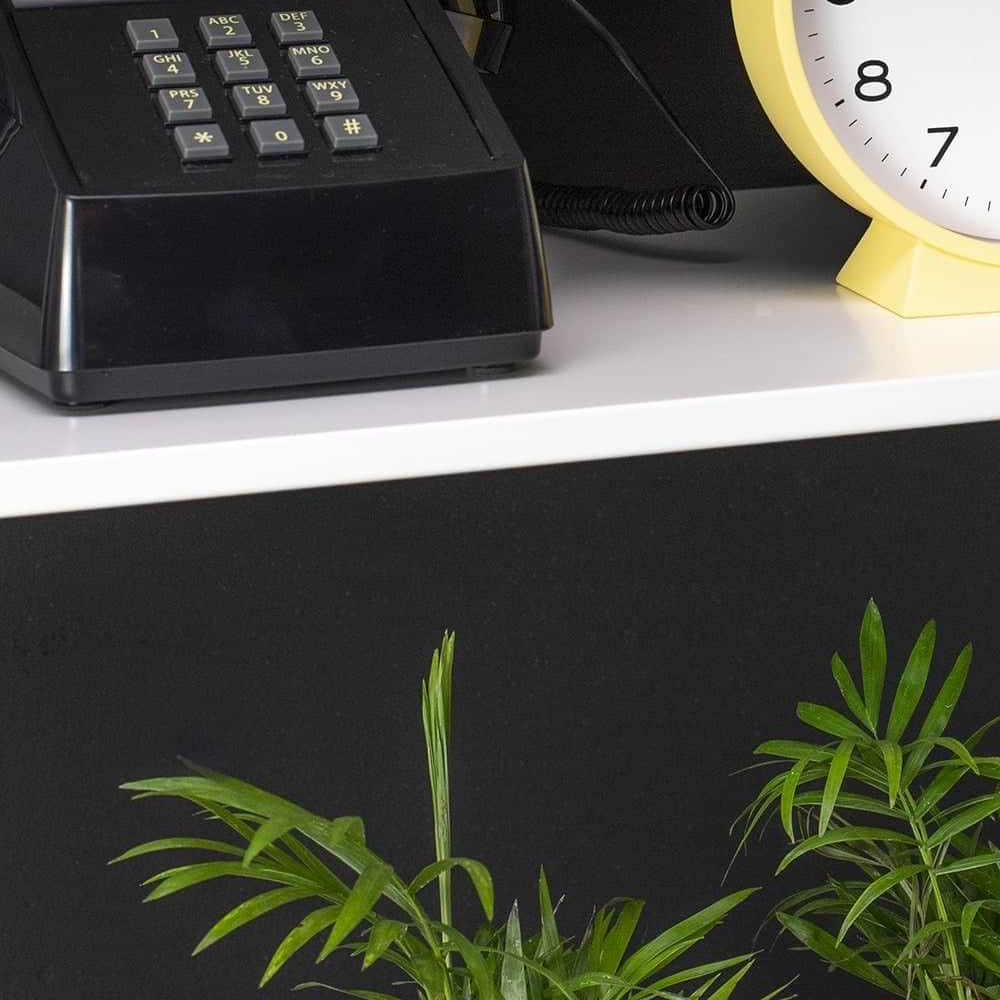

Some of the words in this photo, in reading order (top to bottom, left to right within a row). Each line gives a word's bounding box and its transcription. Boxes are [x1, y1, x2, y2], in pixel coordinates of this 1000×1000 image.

[208, 15, 240, 25] ABC
[279, 12, 308, 21] DEF
[223, 25, 236, 36] 2
[294, 21, 306, 32] 3
[150, 29, 160, 40] 1
[227, 49, 254, 58] JKL
[292, 45, 330, 56] MNO
[153, 54, 182, 64] GHI
[311, 55, 324, 65] 6
[167, 63, 179, 75] 4
[311, 80, 348, 91] WXY
[854, 59, 893, 103] 8
[168, 88, 200, 99] PRS
[241, 84, 273, 95] TUV
[256, 94, 270, 106] 8
[330, 90, 343, 101] 9
[183, 98, 194, 110] 7
[927, 126, 959, 168] 7
